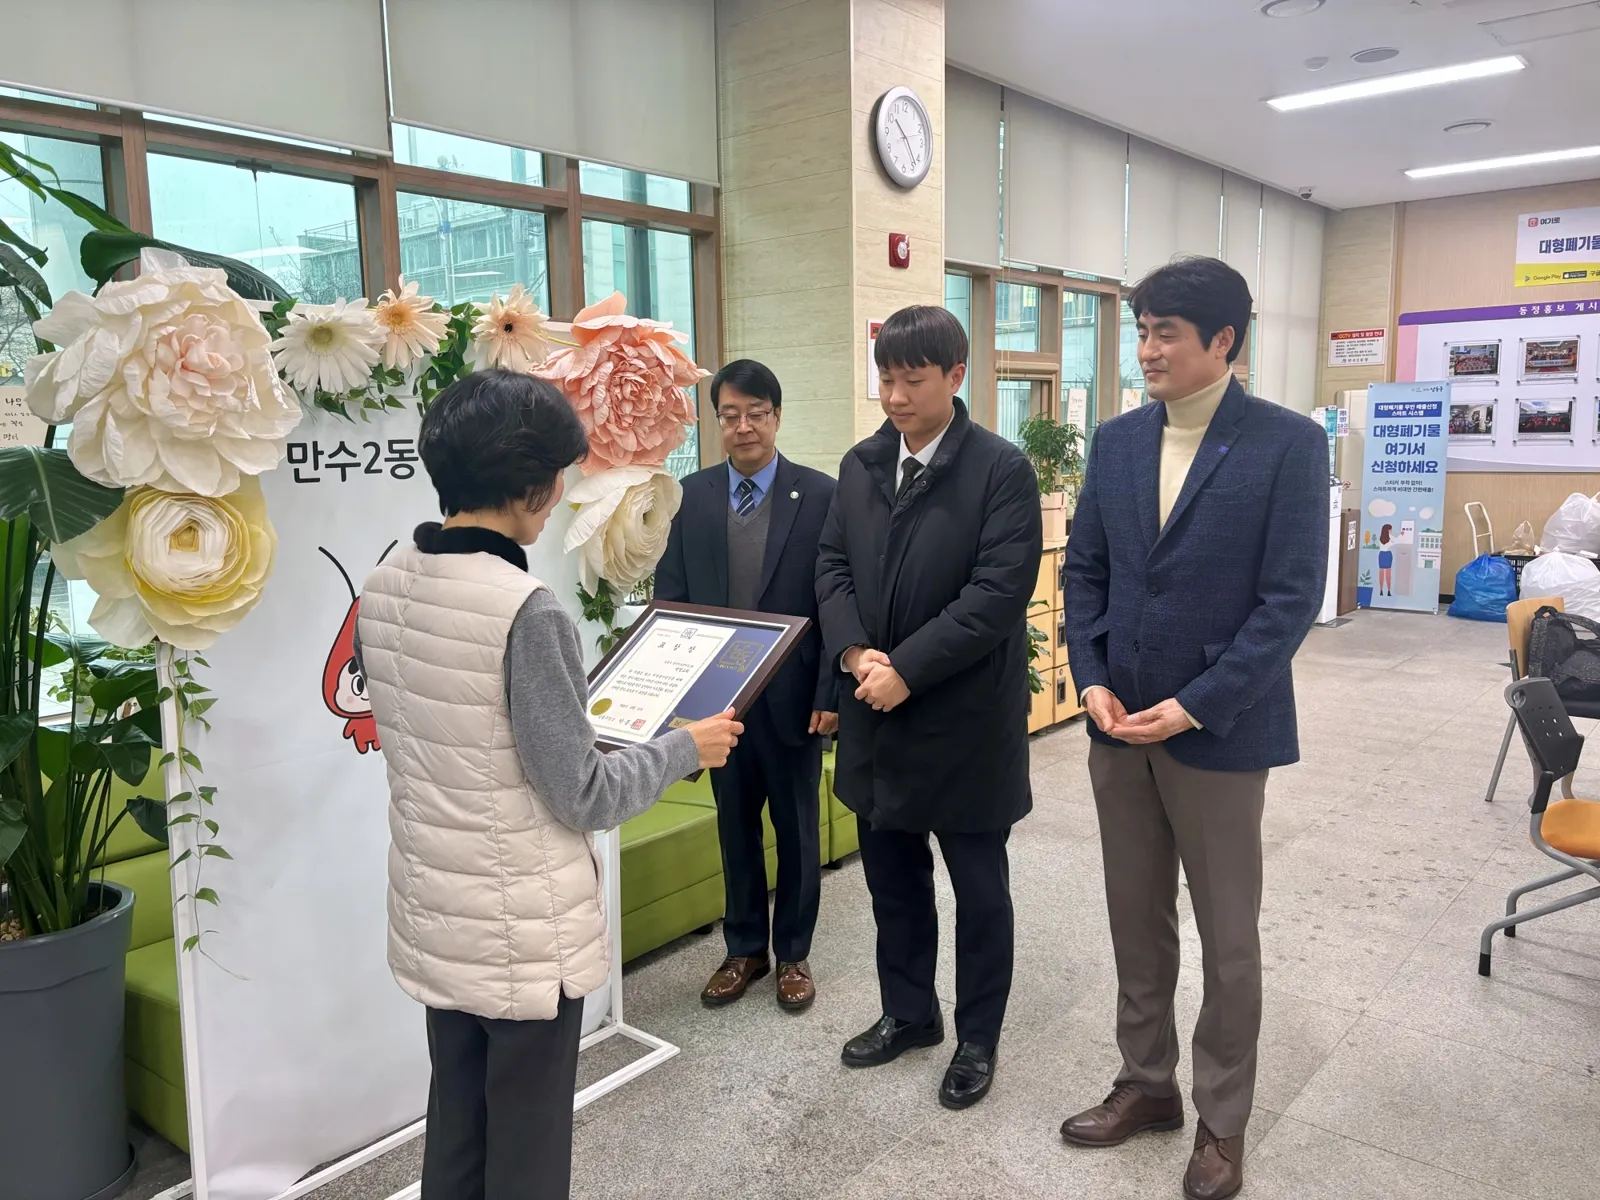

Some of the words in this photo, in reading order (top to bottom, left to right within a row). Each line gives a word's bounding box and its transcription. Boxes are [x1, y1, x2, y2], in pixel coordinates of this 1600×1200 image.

[1540, 217, 1560, 225] 여기로
[1373, 424, 1441, 437] 대형폐기물
[1385, 442, 1425, 455] 여기서
[286, 439, 419, 483] 만수2동
[1371, 460, 1438, 474] 신청하세요
